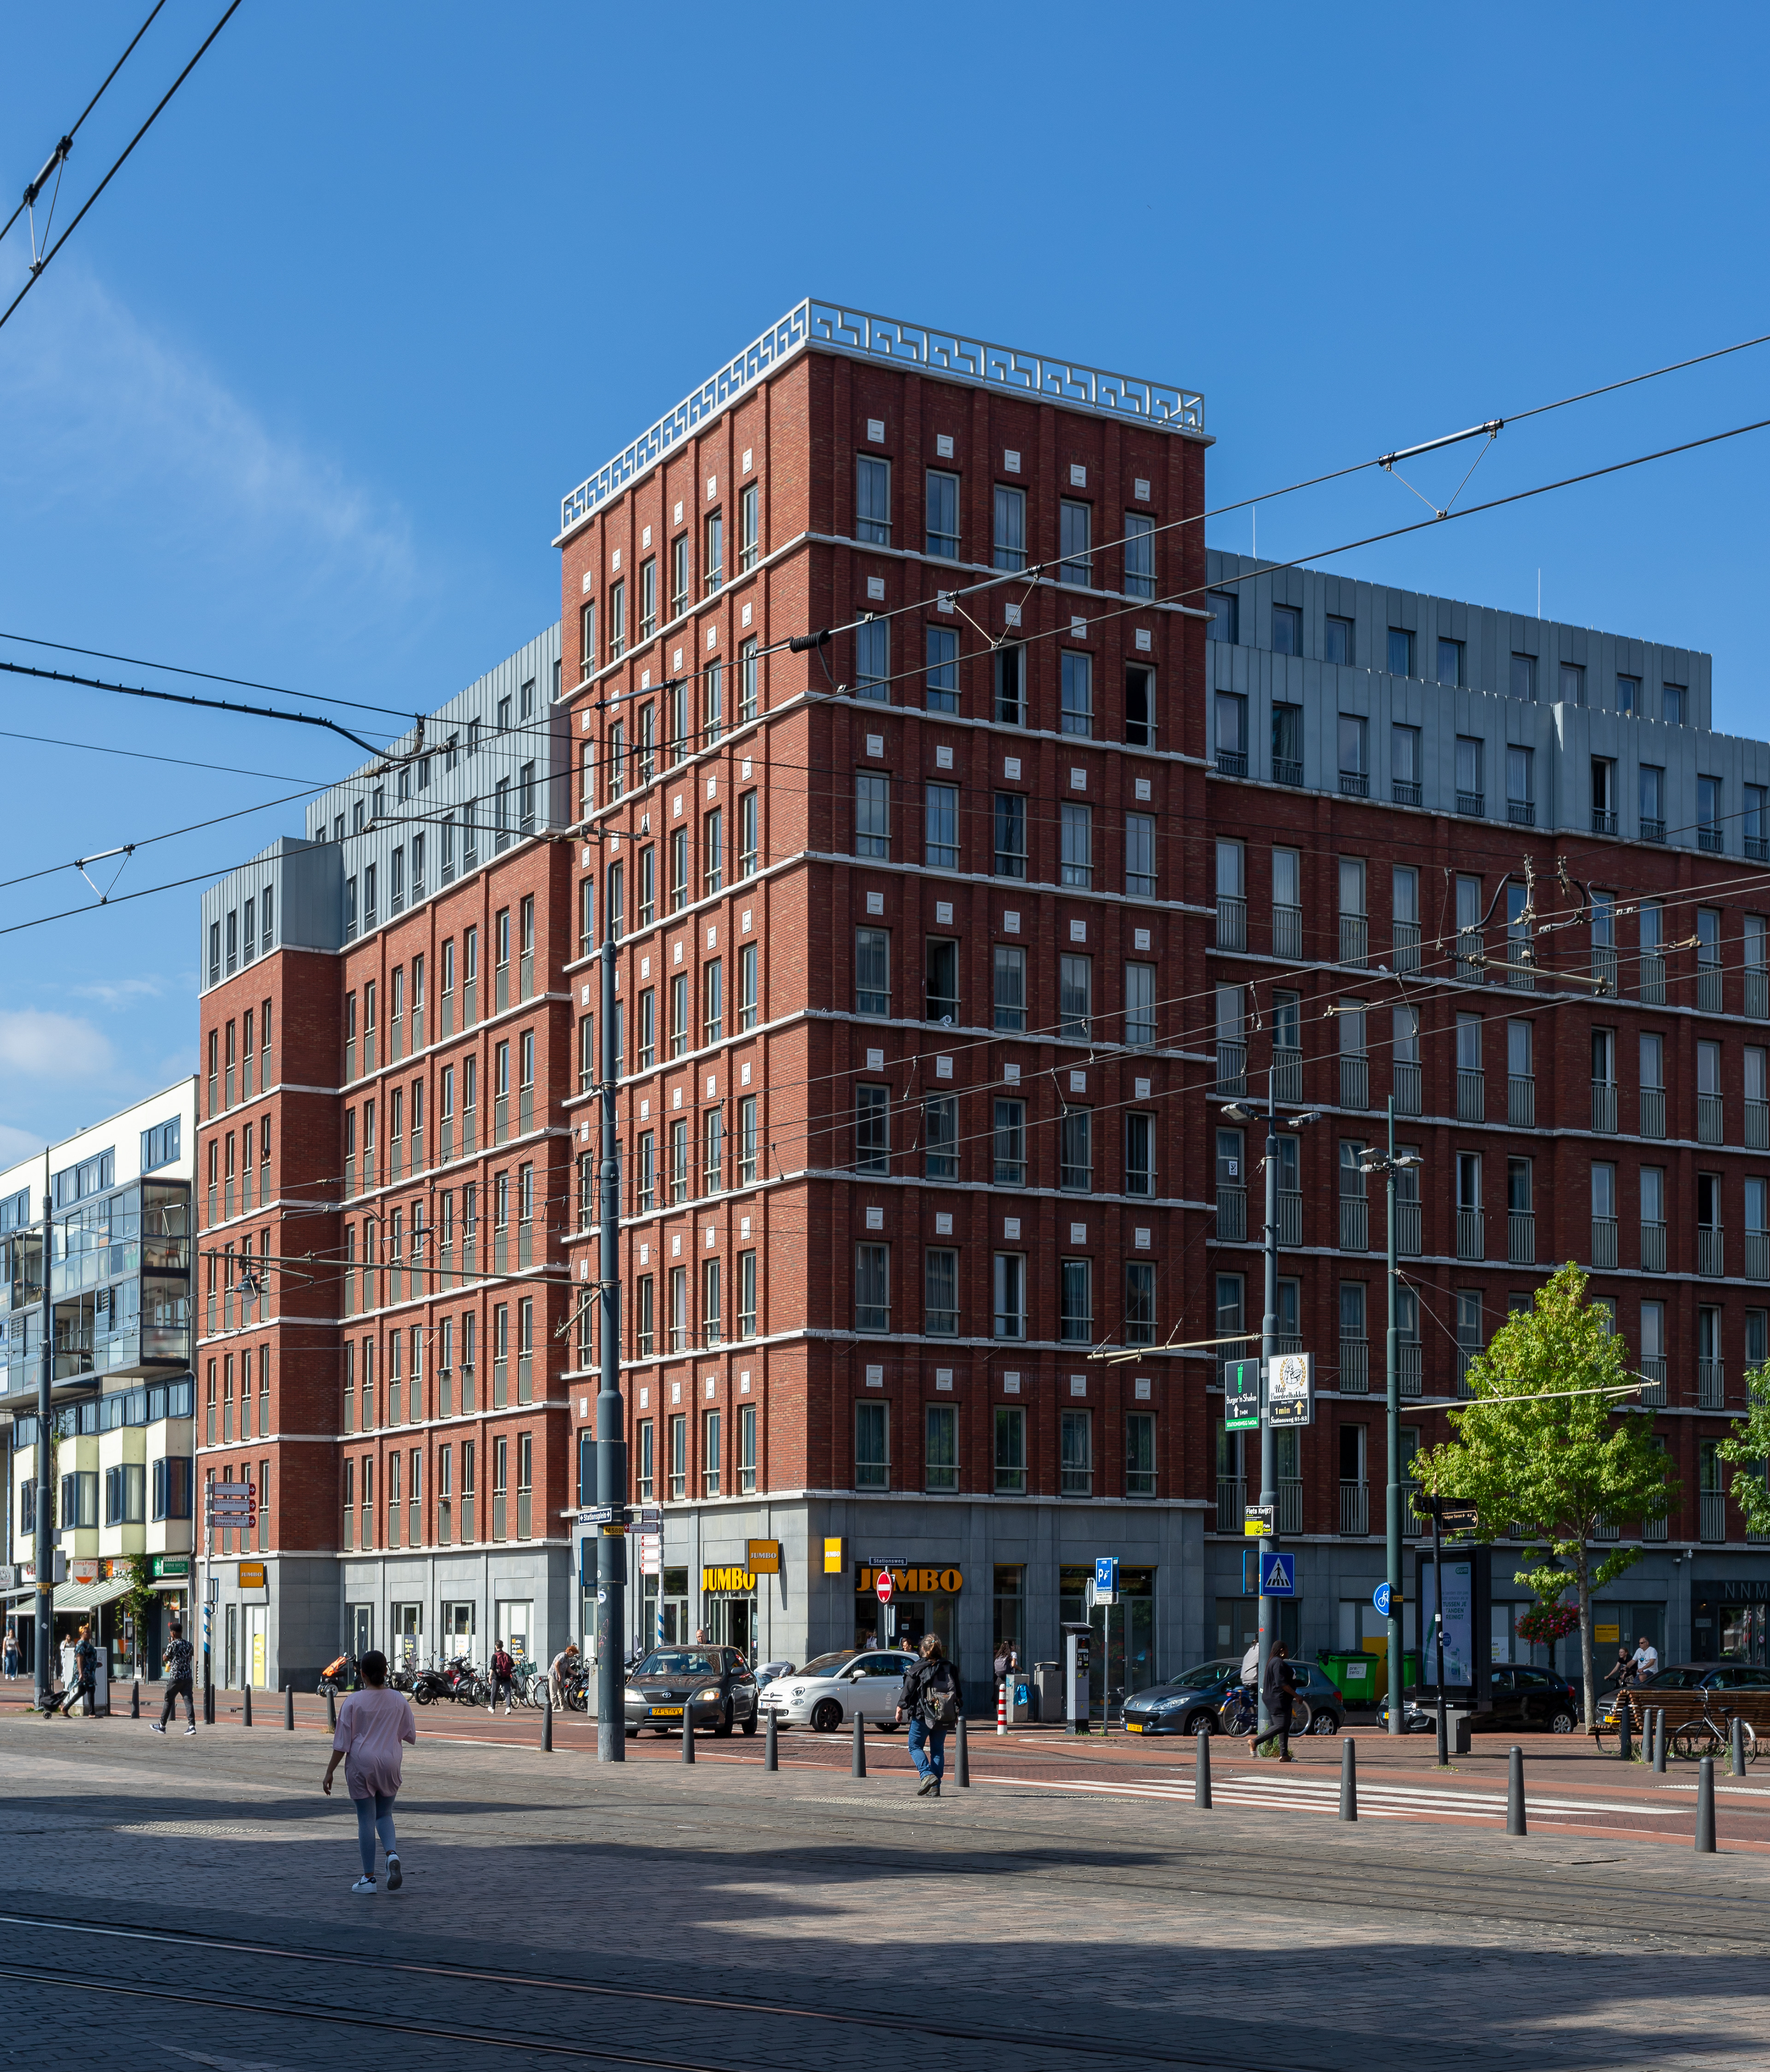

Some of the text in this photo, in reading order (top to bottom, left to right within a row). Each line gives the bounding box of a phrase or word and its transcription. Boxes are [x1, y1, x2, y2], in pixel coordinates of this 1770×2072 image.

[1274, 1384, 1286, 1393] Uw
[1227, 1395, 1239, 1405] Burger
[1243, 1393, 1257, 1402] Shake
[1270, 1391, 1307, 1400] Voordeelbakker
[1270, 1416, 1294, 1424] Stationsweg
[1258, 1507, 1271, 1515] Kwijt?
[583, 1511, 607, 1521] Stationsplein
[701, 1568, 755, 1591] JUMBO
[856, 1568, 963, 1592] JUMBO
